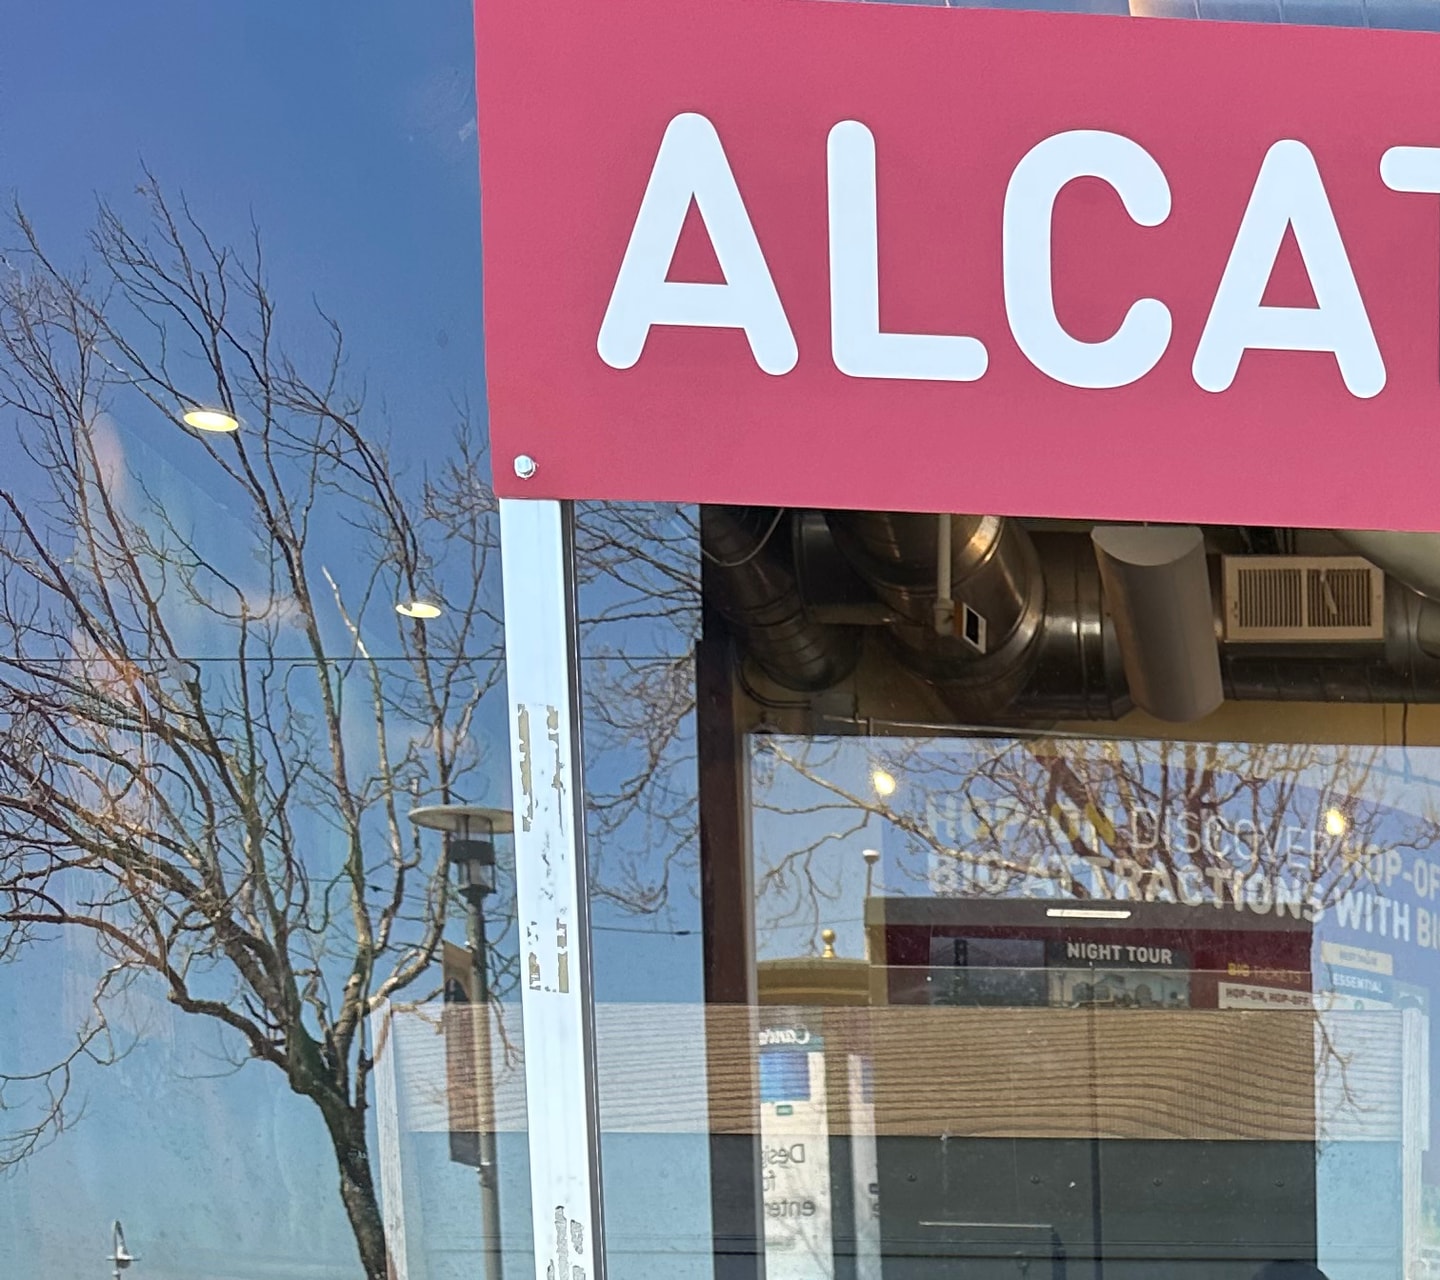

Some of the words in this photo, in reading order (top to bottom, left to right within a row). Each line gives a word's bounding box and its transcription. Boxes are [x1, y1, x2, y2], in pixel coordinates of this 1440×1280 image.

[1333, 886, 1411, 943] WITH
[1067, 942, 1122, 961] NIGHT
[1126, 946, 1173, 965] TOUR
[1228, 962, 1250, 978] BIG
[1333, 972, 1384, 994] ESSENTIAL
